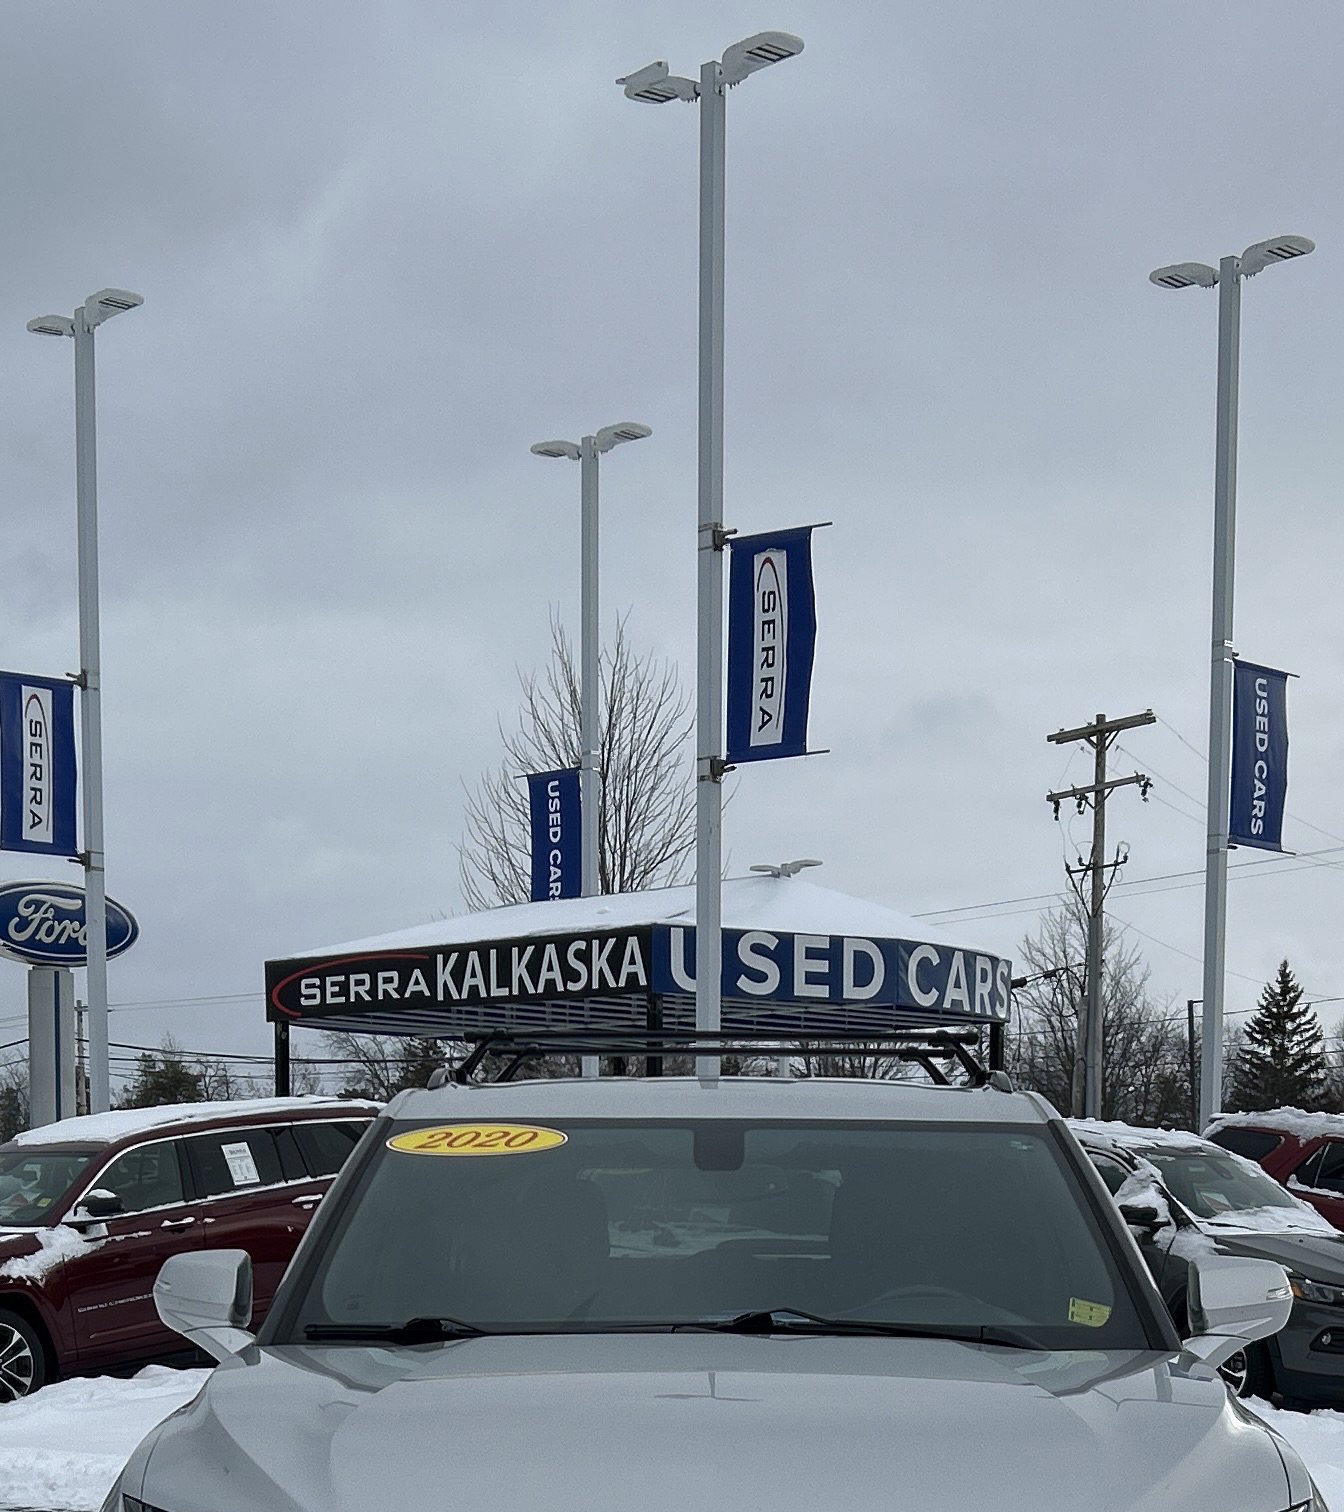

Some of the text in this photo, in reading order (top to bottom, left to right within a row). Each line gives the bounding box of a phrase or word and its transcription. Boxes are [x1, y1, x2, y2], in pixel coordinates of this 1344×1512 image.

[758, 589, 777, 733] SERRA
[29, 718, 42, 830] SERRA
[1251, 677, 1269, 835] USED CARS
[547, 780, 562, 900] USED CAR
[300, 936, 648, 1006] SERRA KALKASKA
[908, 943, 1008, 1019] CARS
[413, 1130, 539, 1150] 2020
